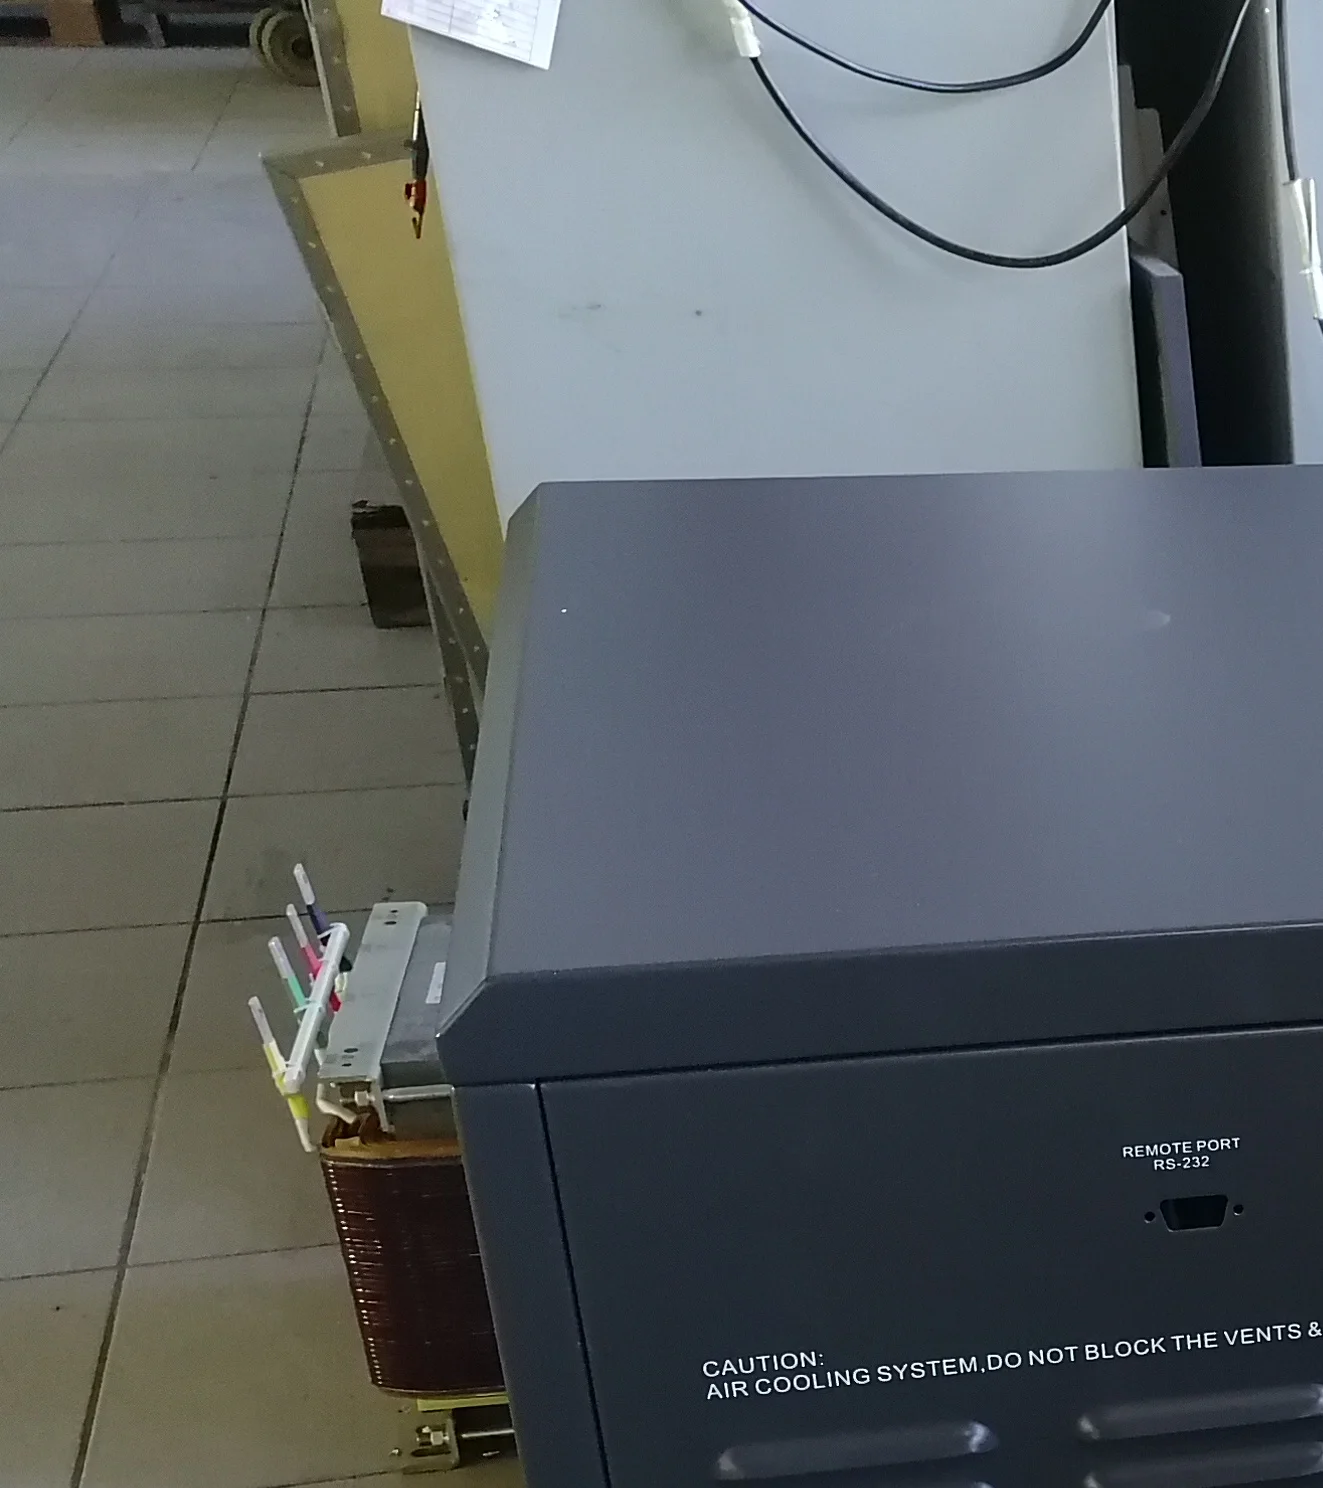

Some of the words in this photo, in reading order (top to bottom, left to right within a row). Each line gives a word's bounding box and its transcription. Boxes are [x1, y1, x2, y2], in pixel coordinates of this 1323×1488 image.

[1122, 1141, 1192, 1158] REMOTE
[1196, 1137, 1240, 1152] PORT
[1153, 1155, 1210, 1171] RS-232
[702, 1351, 824, 1378] CAUTION:
[707, 1379, 749, 1400] AIR
[754, 1367, 871, 1395] COOLING
[1028, 1345, 1078, 1367] NOT
[1085, 1337, 1166, 1361] BLOCK
[1170, 1331, 1218, 1352] THE
[1223, 1323, 1301, 1346] VENTS
[1308, 1321, 1322, 1337] &
